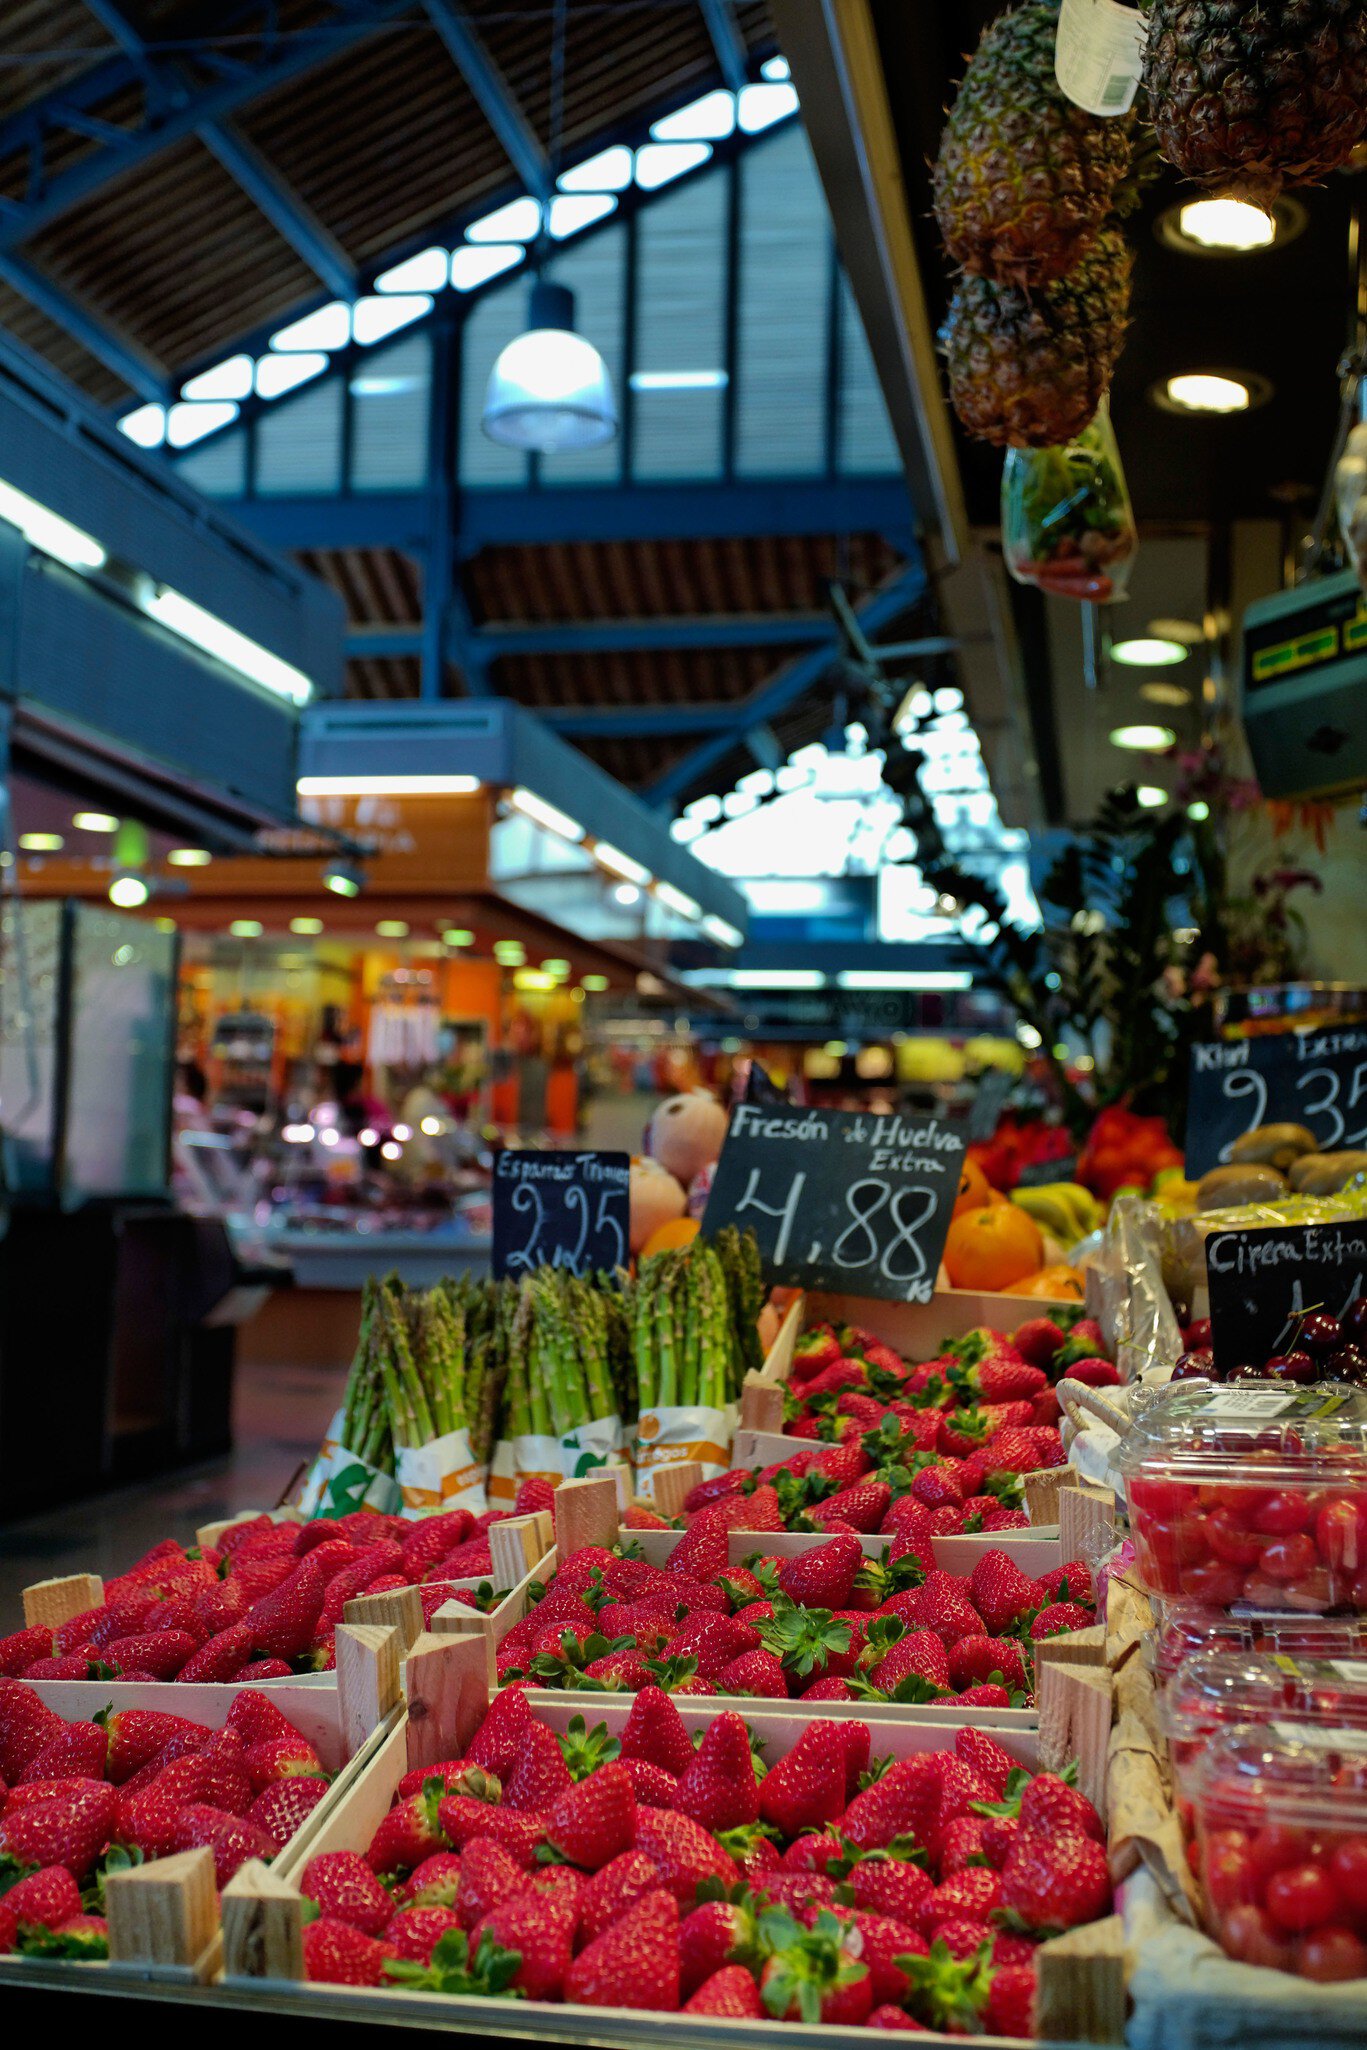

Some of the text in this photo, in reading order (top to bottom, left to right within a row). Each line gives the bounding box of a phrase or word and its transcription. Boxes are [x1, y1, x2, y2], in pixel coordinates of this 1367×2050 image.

[730, 1103, 829, 1140] Fresón
[870, 1115, 965, 1152] Huelva
[868, 1149, 947, 1173] Extra
[734, 1167, 938, 1282] 4,88
